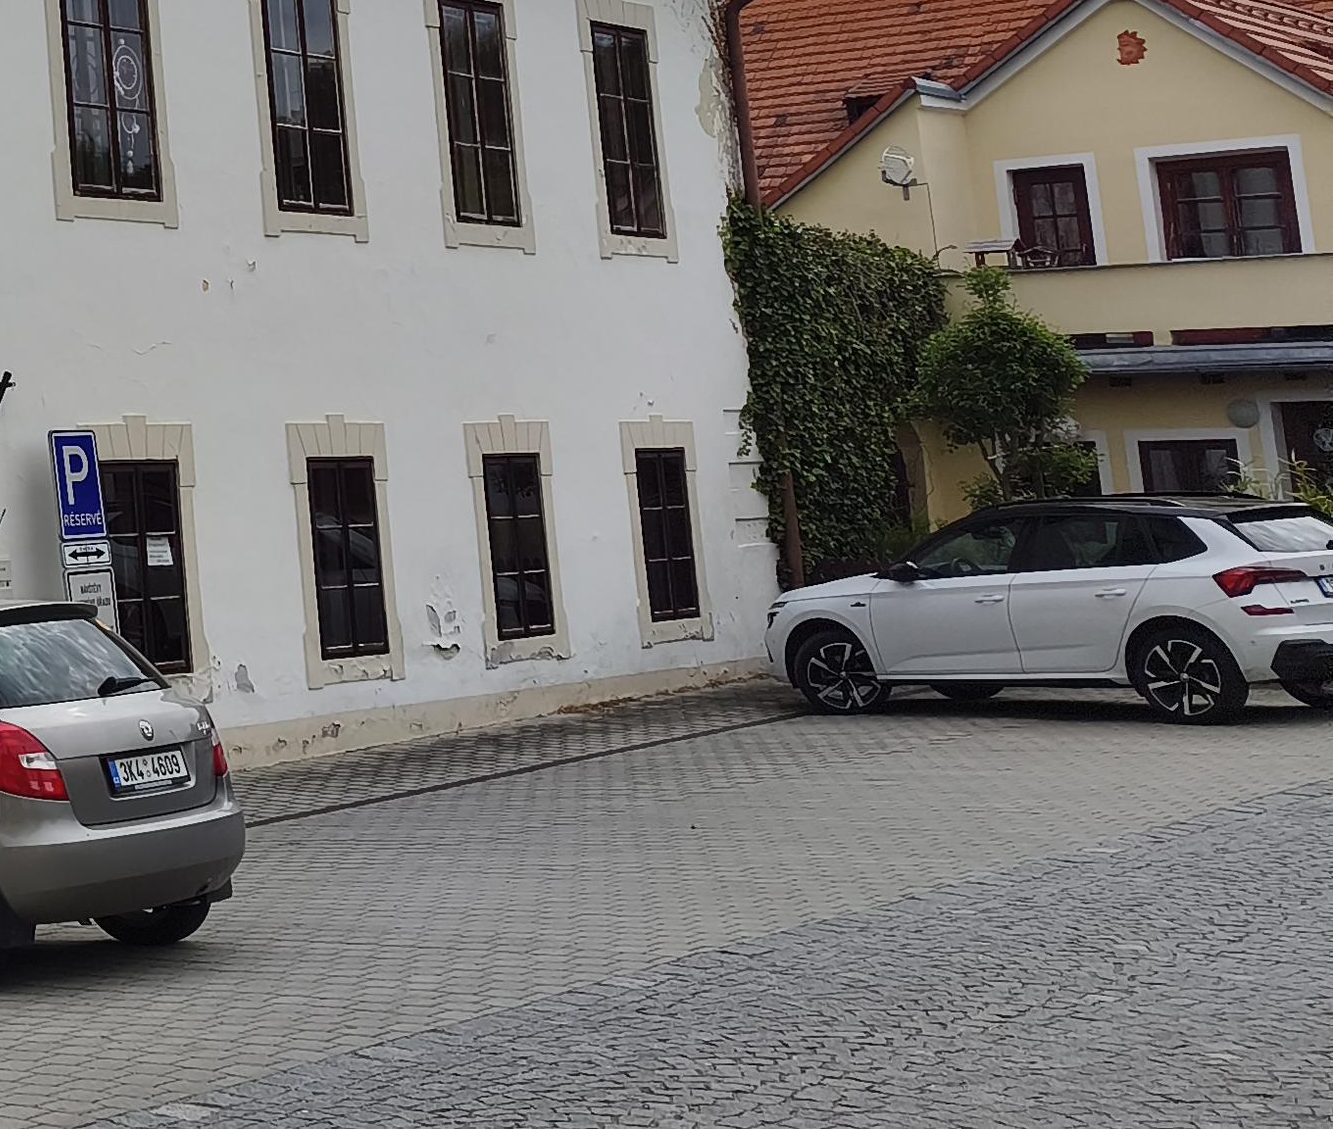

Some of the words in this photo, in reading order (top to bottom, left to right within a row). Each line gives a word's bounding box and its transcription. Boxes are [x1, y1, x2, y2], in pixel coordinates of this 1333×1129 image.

[62, 445, 89, 505] P
[63, 509, 103, 526] RÉSERVÉ
[151, 753, 181, 777] 4609
